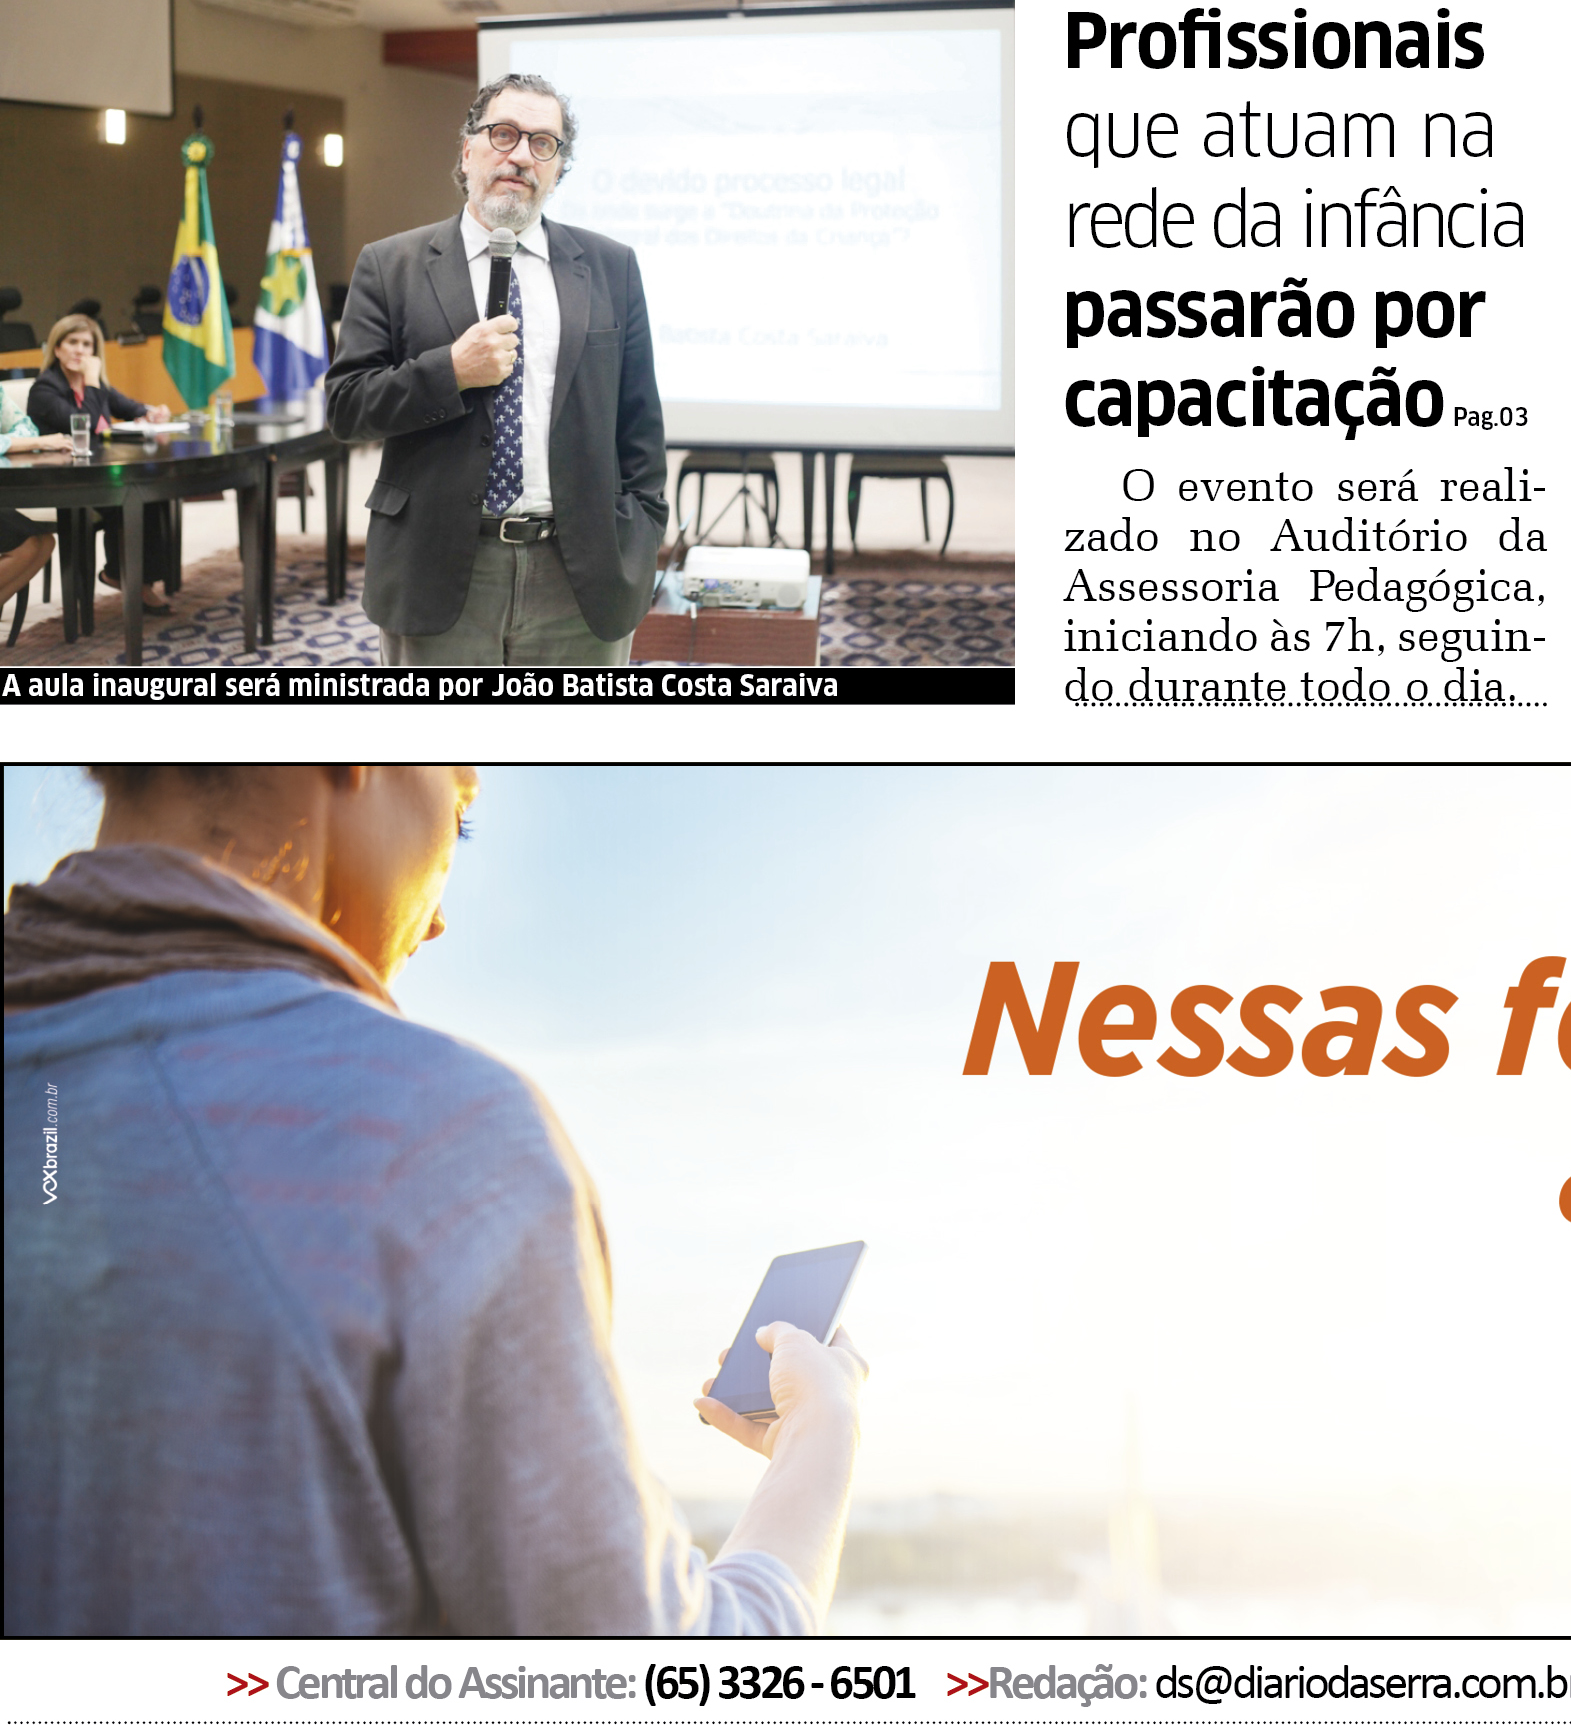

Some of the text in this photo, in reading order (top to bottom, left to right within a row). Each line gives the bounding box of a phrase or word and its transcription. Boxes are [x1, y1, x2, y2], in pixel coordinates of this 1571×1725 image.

[1067, 7, 1485, 70] Profissionais
[1066, 276, 1487, 349] passarão por
[1065, 365, 1444, 441] capacitação
[1454, 406, 1529, 431] Pag.03
[1062, 566, 1545, 613] Assessoria Pedagógica,
[961, 960, 1460, 1078] Nessas
[276, 1663, 917, 1707] Central do Assinante: (65) 3326 6501
